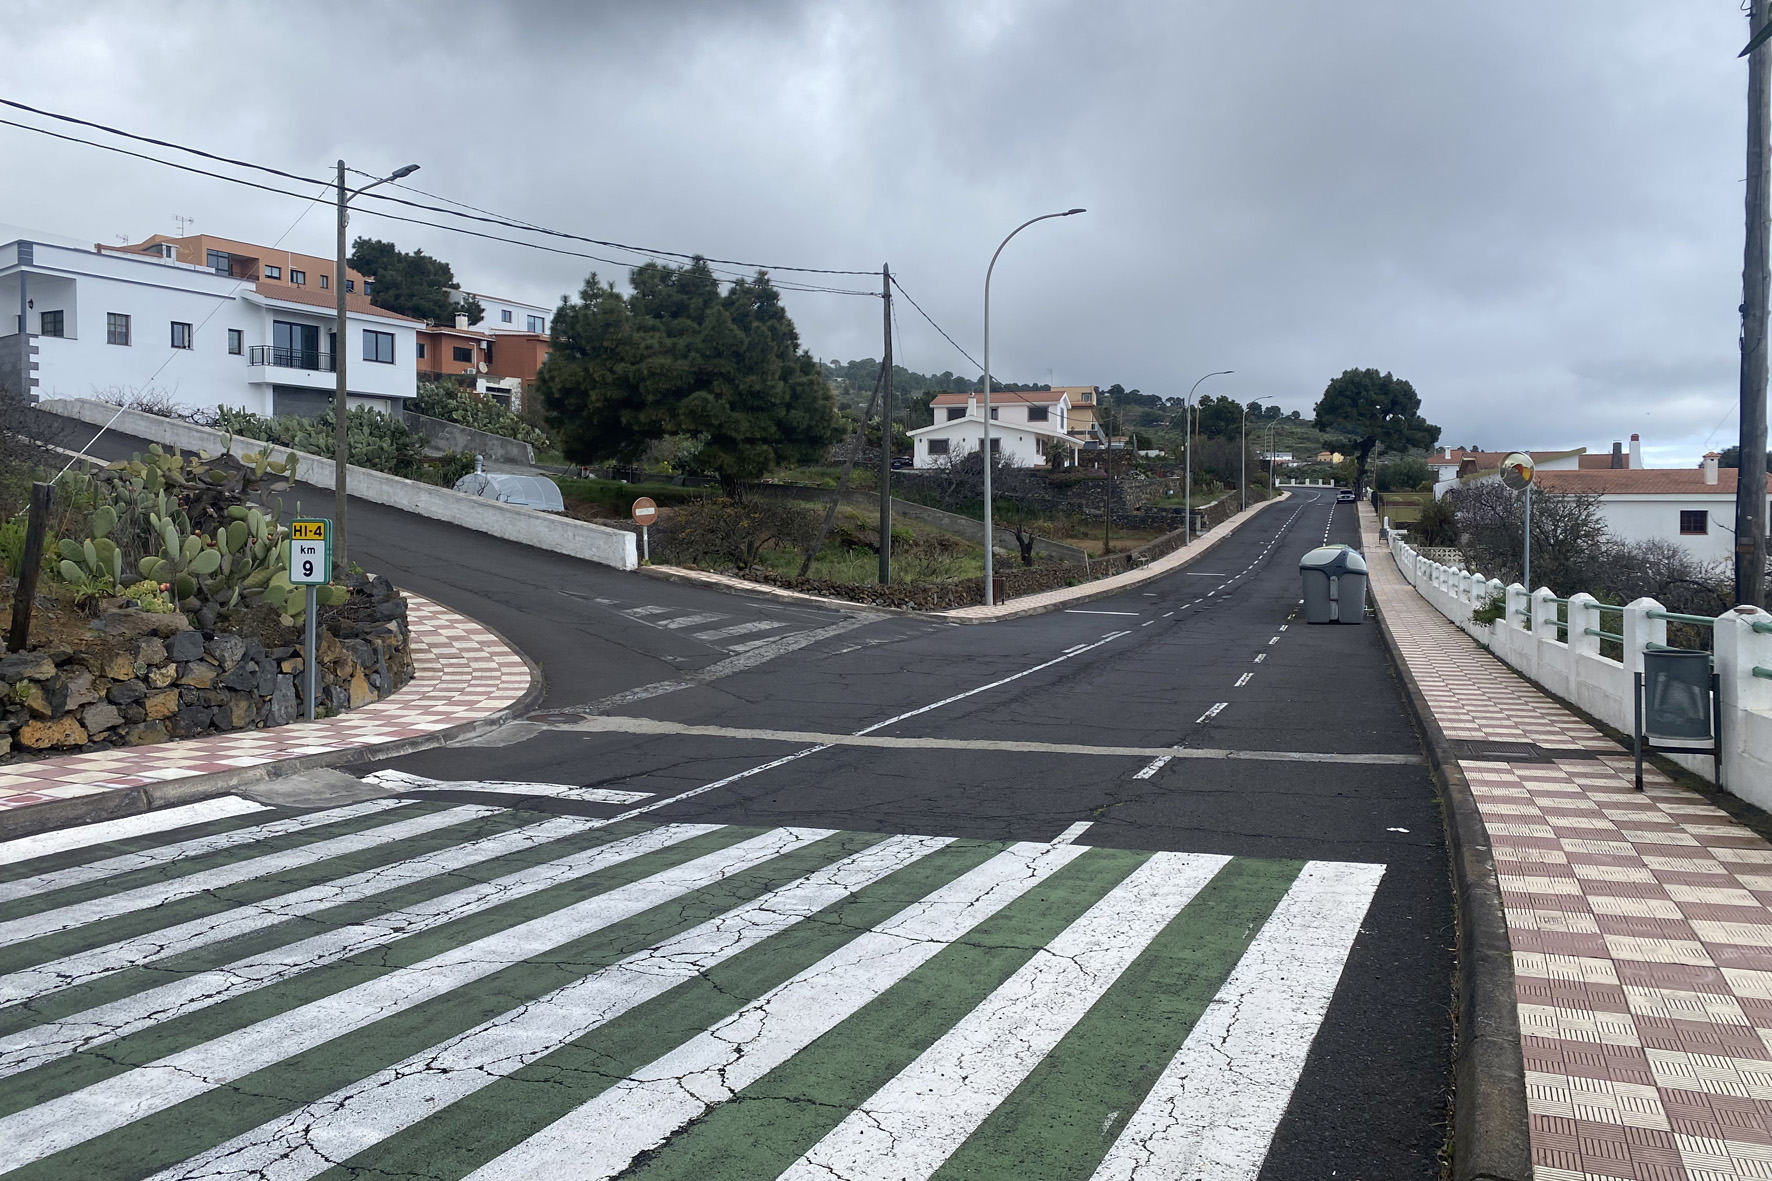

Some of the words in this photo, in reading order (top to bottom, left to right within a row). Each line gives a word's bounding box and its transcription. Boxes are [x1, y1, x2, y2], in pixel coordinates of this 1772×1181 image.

[293, 525, 322, 537] HI-4
[300, 545, 316, 554] km
[302, 560, 314, 577] 9
